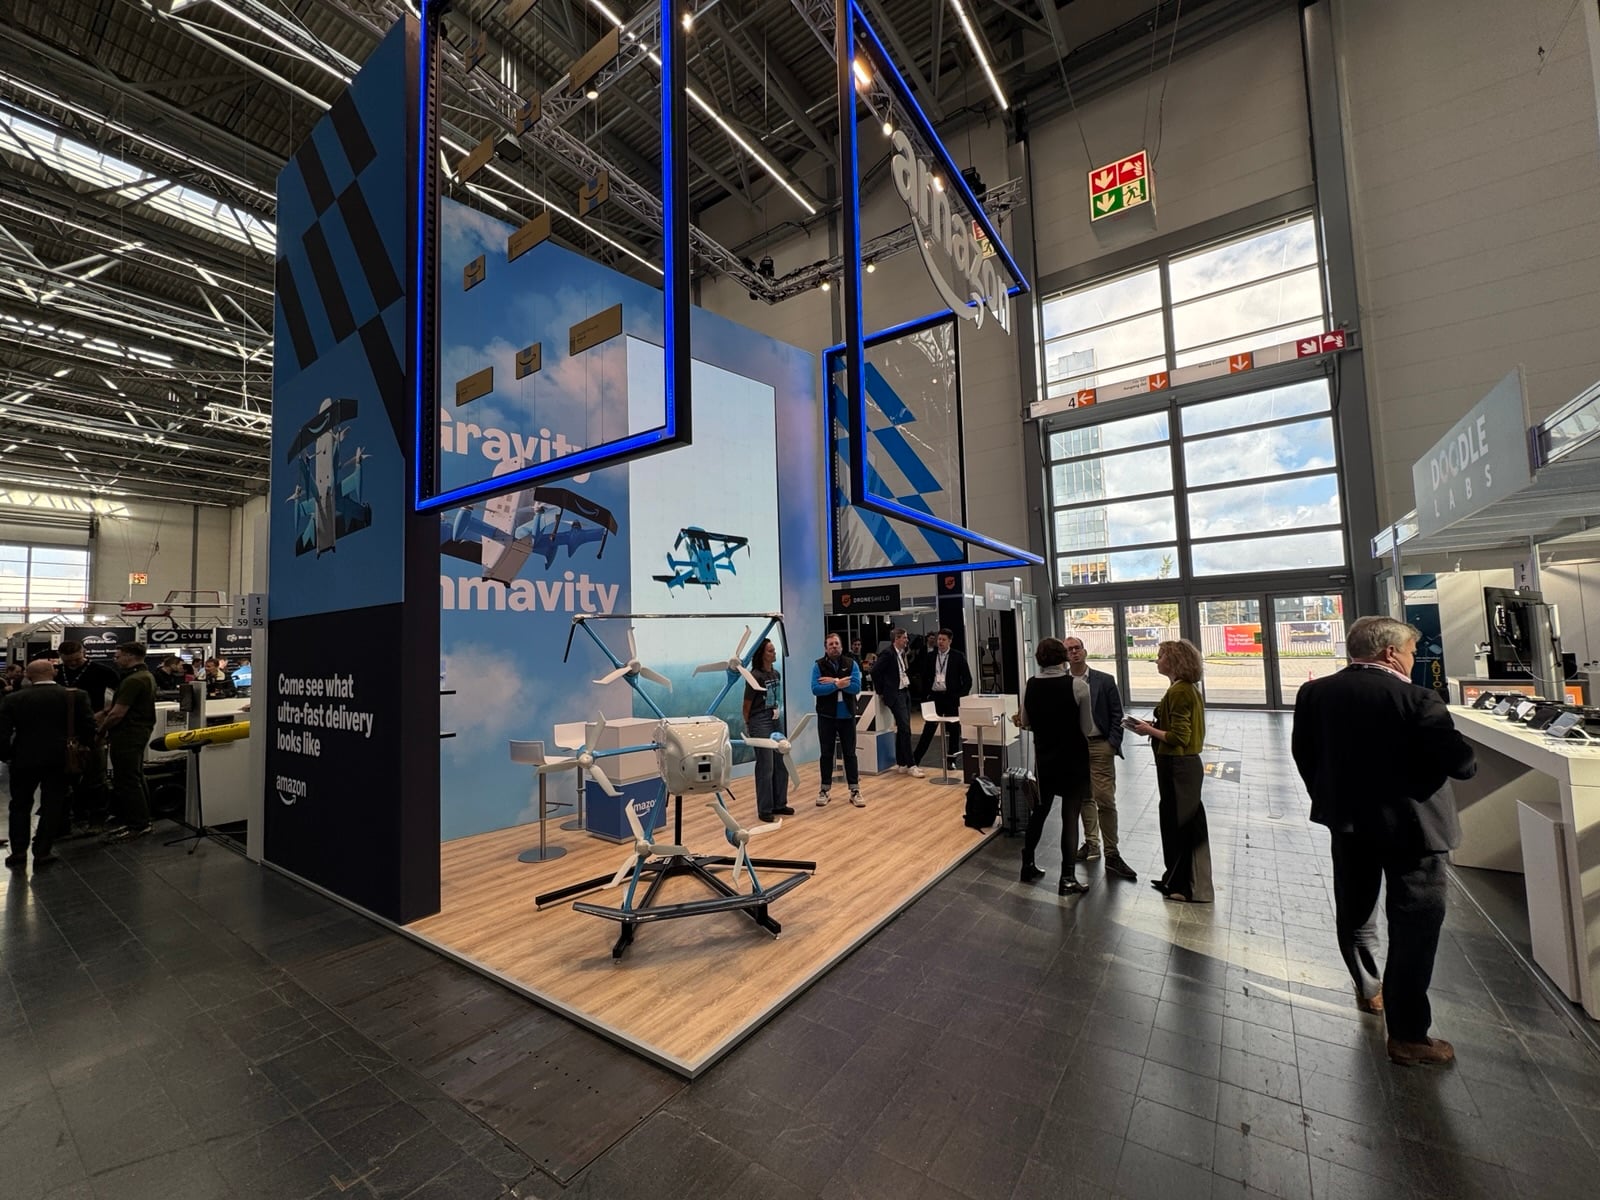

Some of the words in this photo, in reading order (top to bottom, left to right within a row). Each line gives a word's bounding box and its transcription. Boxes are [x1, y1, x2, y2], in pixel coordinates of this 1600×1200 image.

[891, 130, 1010, 335] amazon
[1068, 397, 1076, 409] 4
[1430, 414, 1489, 491] DOODLE
[1433, 464, 1492, 518] LABS
[253, 618, 263, 626] 55
[181, 632, 213, 640] CYBE
[278, 672, 304, 695] Come
[305, 678, 324, 697] see
[325, 673, 354, 698] what
[277, 701, 325, 728] ultra-fast
[325, 704, 374, 738] delivery
[277, 728, 302, 754] looks
[302, 731, 321, 757] like
[276, 775, 307, 799] amazon
